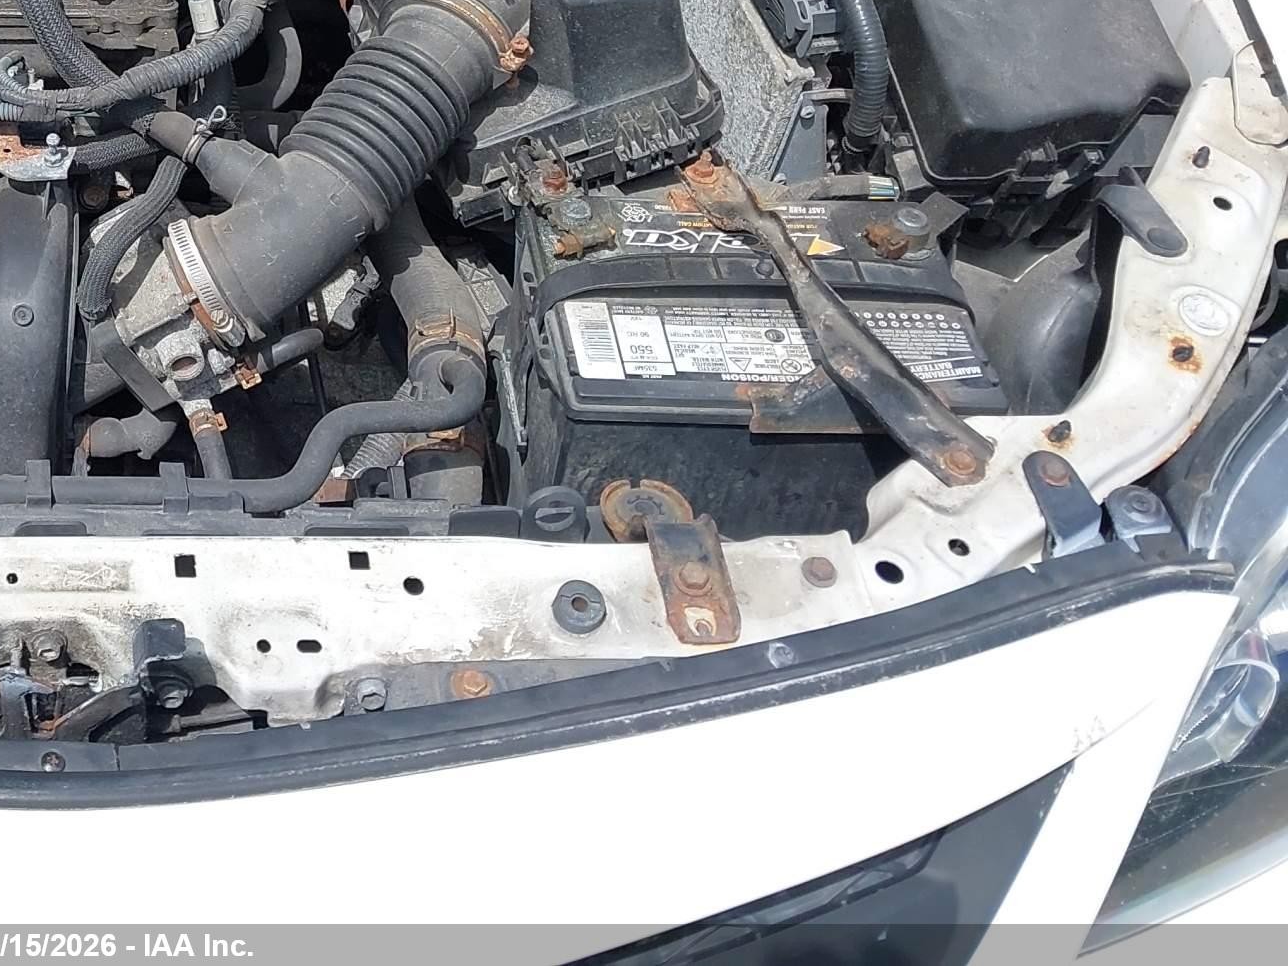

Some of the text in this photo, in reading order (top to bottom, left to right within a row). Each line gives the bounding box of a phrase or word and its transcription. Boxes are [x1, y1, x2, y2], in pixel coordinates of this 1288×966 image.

[630, 345, 654, 355] 550
[910, 362, 953, 374] BATTERY
[720, 374, 802, 382] NGER/POISON
